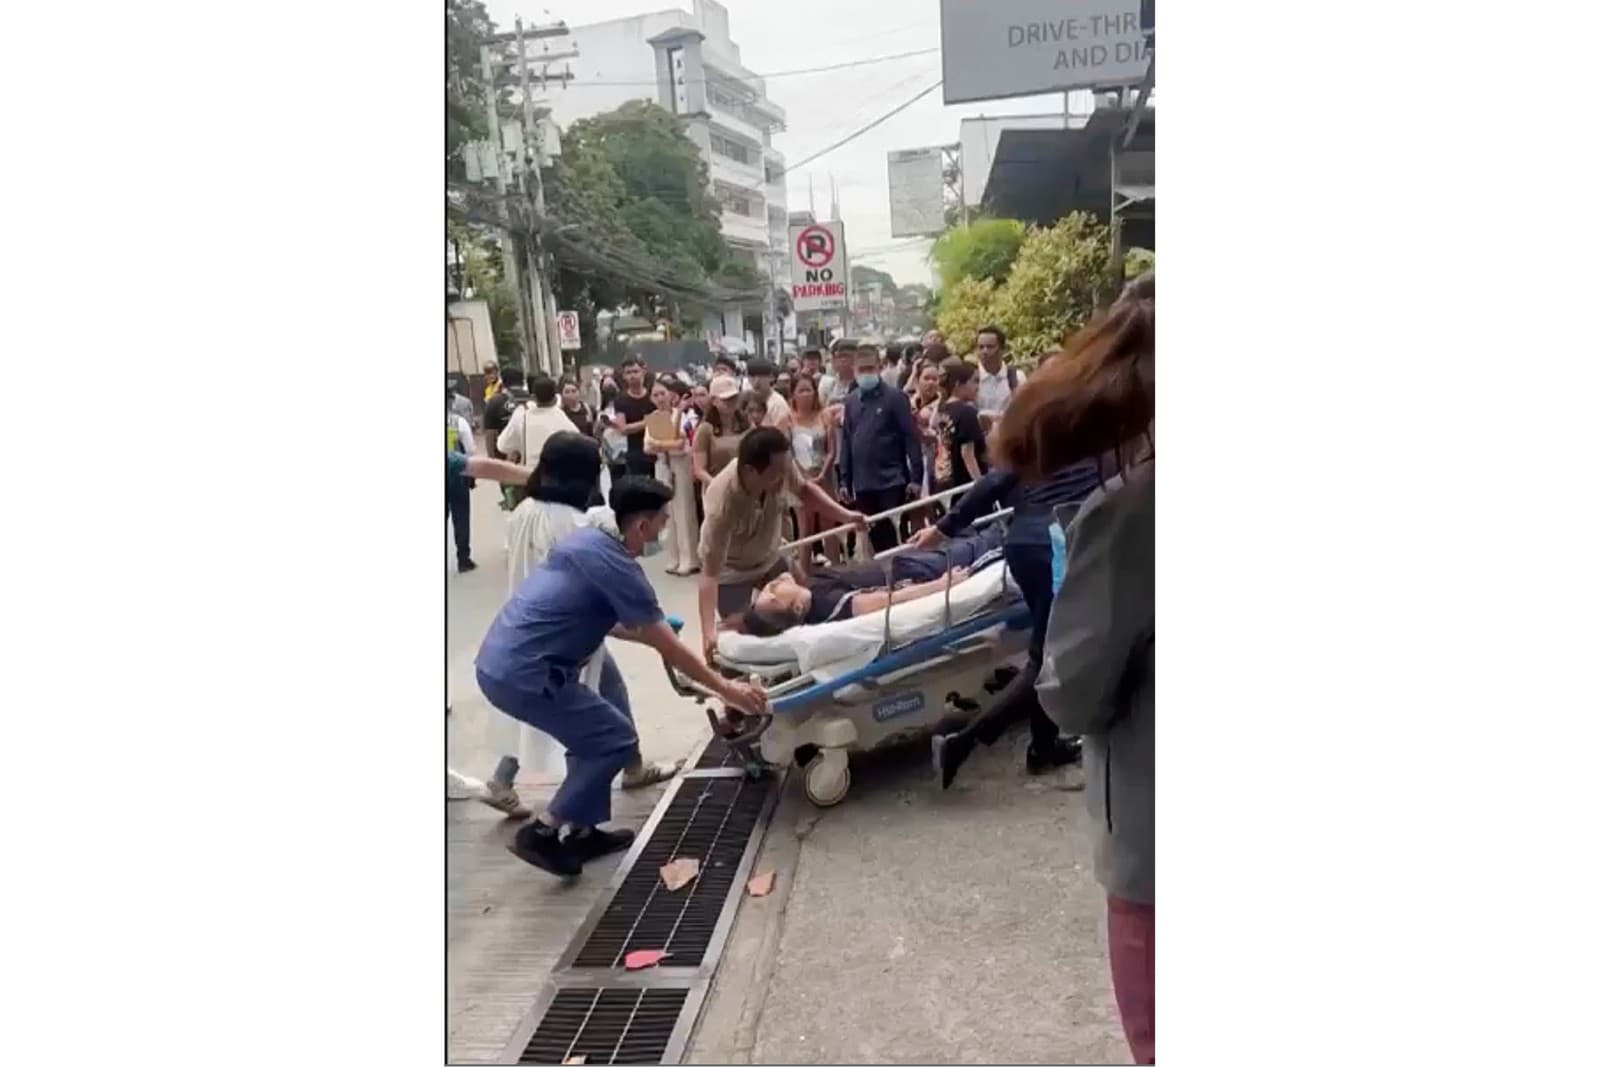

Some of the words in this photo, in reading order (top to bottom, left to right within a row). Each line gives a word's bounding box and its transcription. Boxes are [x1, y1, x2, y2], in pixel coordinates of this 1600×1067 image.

[1053, 45, 1108, 70] AND
[806, 268, 833, 282] NO
[793, 283, 844, 298] PARKING
